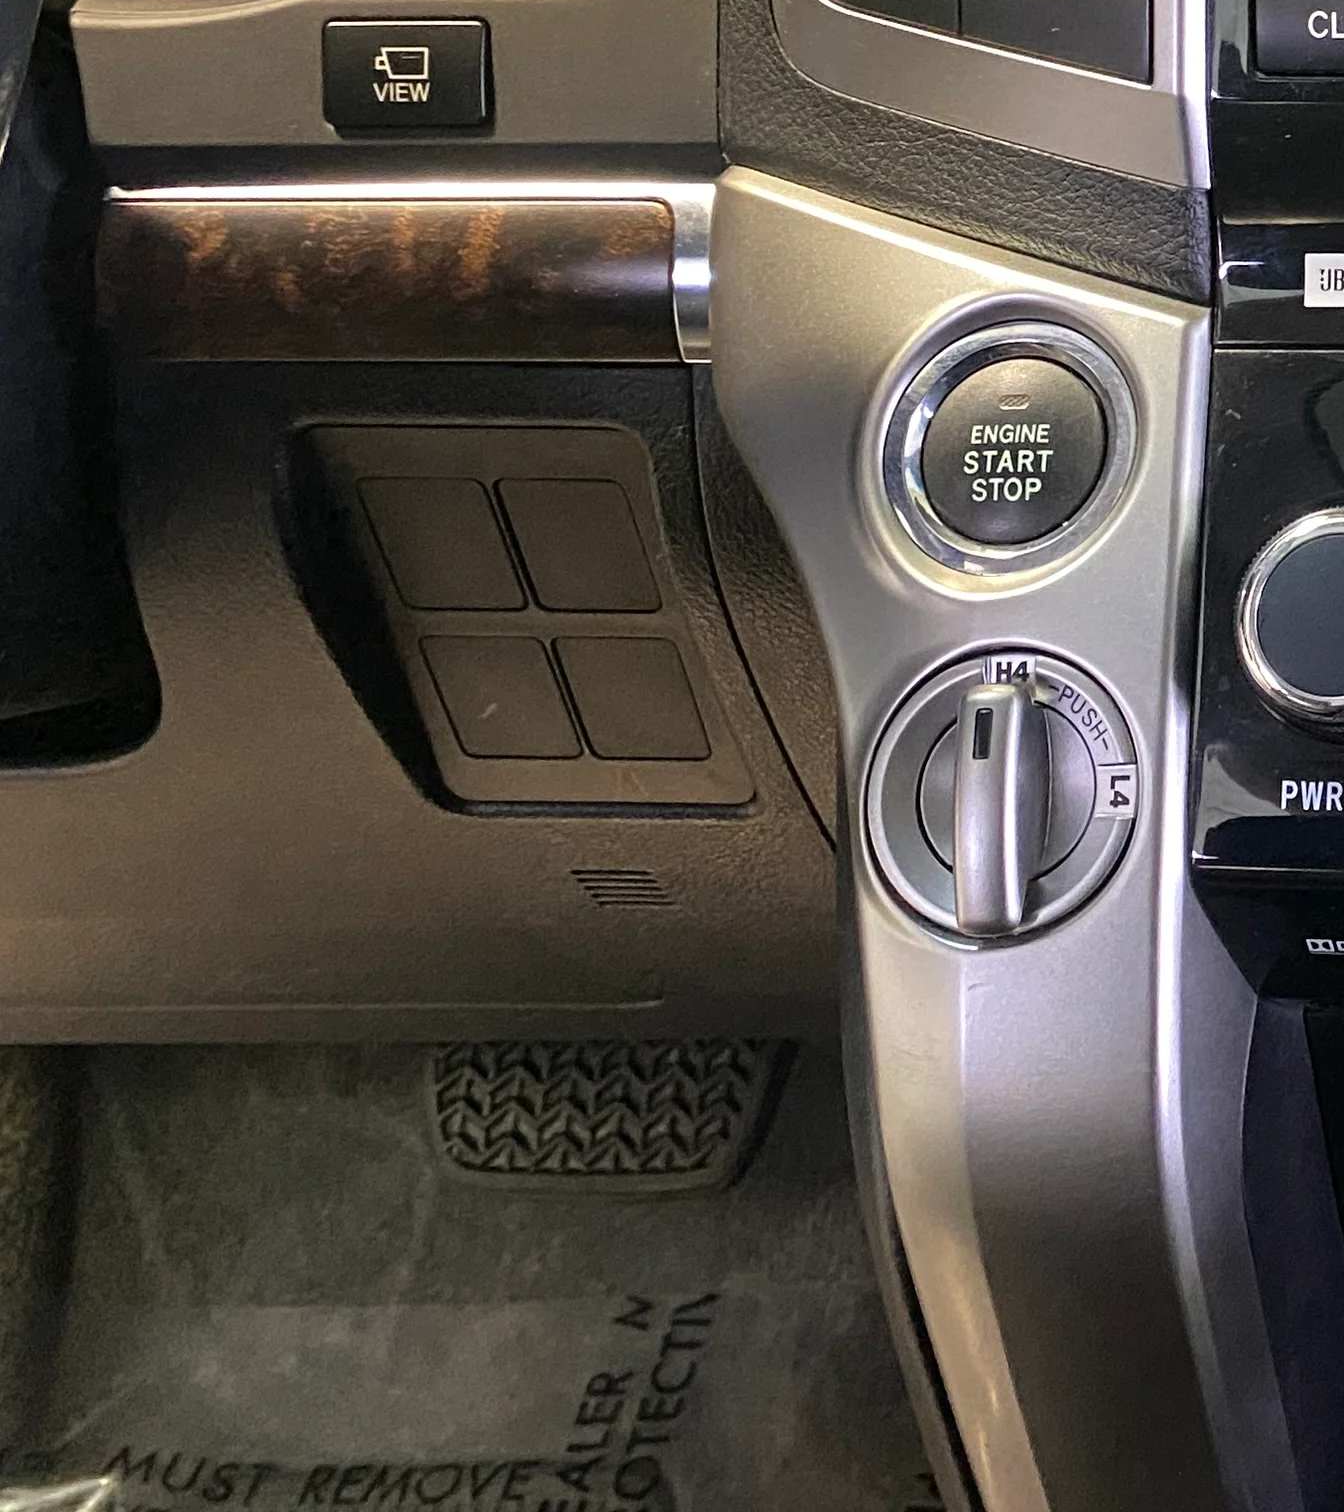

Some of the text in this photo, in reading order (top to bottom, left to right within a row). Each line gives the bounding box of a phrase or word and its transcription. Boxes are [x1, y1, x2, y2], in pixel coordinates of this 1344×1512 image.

[372, 82, 431, 102] VIEW
[970, 423, 1051, 445] ENGINE
[963, 449, 1054, 475] START
[971, 476, 1042, 503] STOP
[996, 661, 1030, 682] H4
[1109, 774, 1131, 809] L4
[101, 1444, 282, 1506] MUST
[298, 1458, 541, 1506] REMOVE
